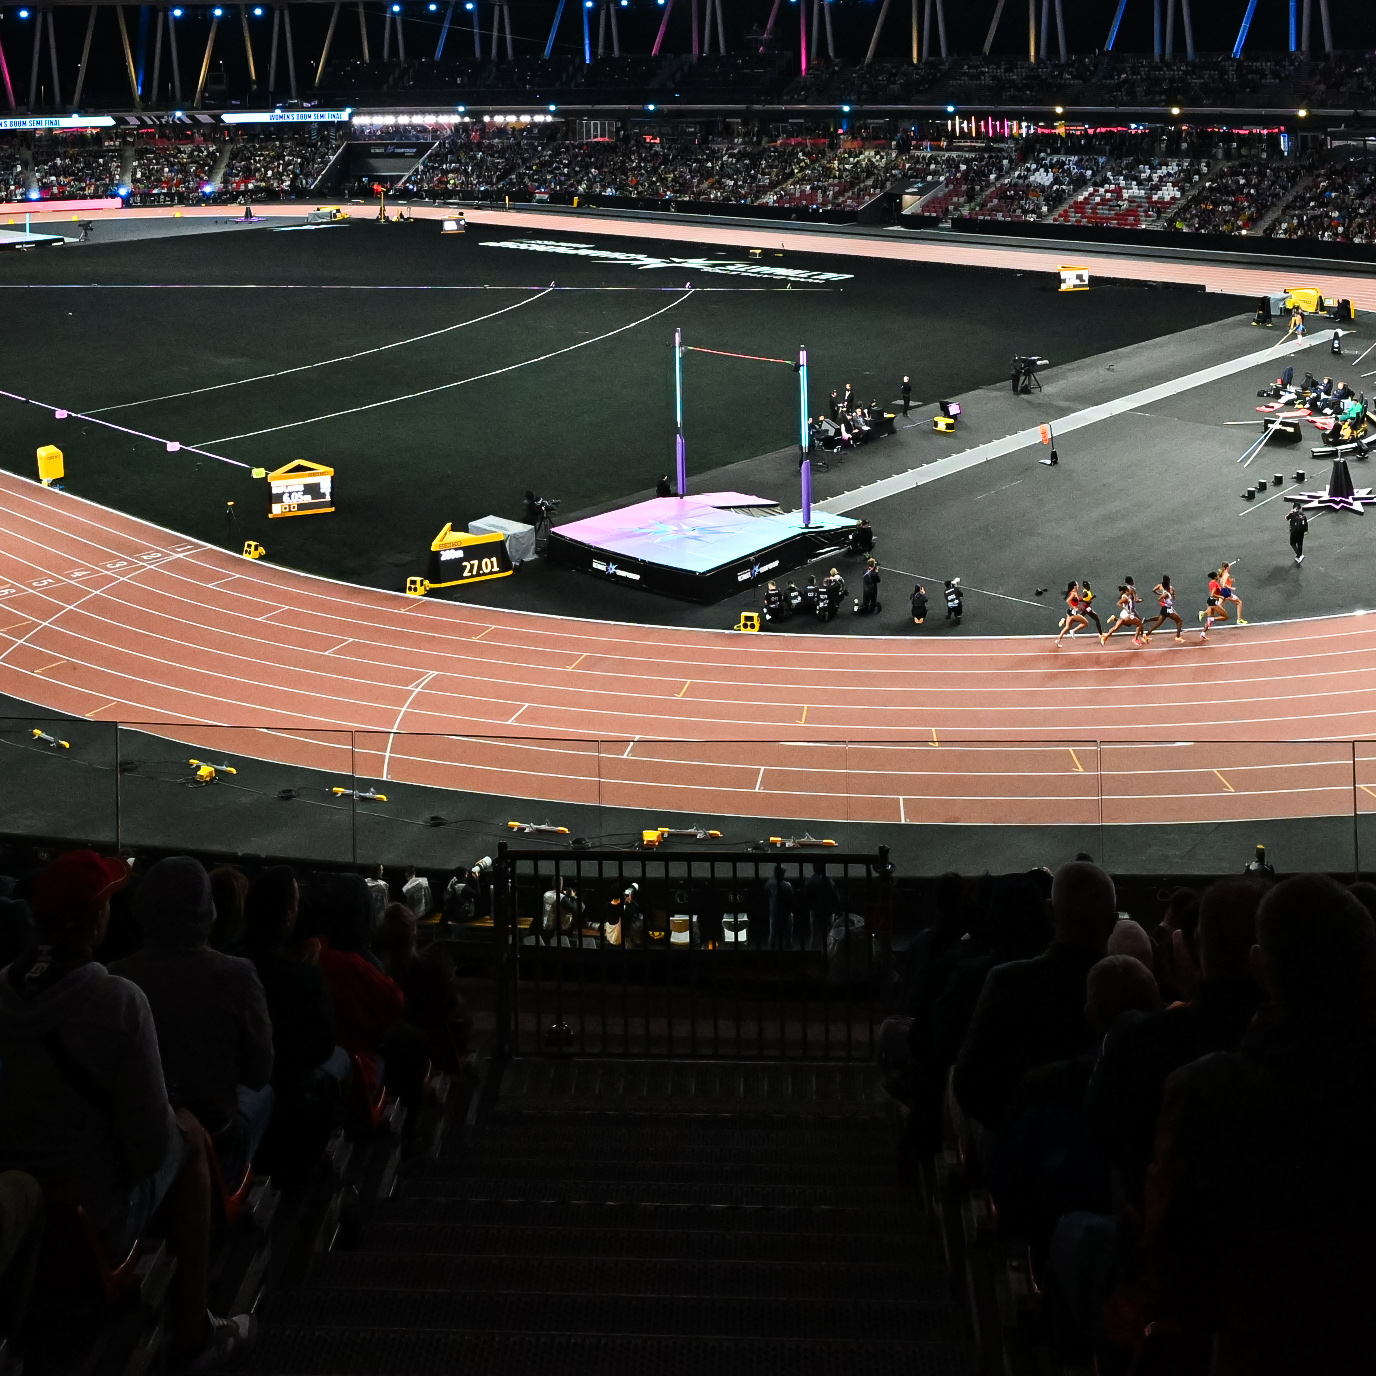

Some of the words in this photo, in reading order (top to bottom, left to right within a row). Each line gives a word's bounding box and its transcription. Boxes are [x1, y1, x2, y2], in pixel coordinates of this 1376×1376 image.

[328, 112, 342, 120] FINAL
[282, 492, 312, 503] 6.05m
[439, 541, 462, 549] SEIKO
[141, 552, 162, 560] 2
[106, 560, 127, 569] 3
[462, 556, 500, 576] 27.01
[71, 569, 91, 578] 4
[34, 578, 54, 588] 5
